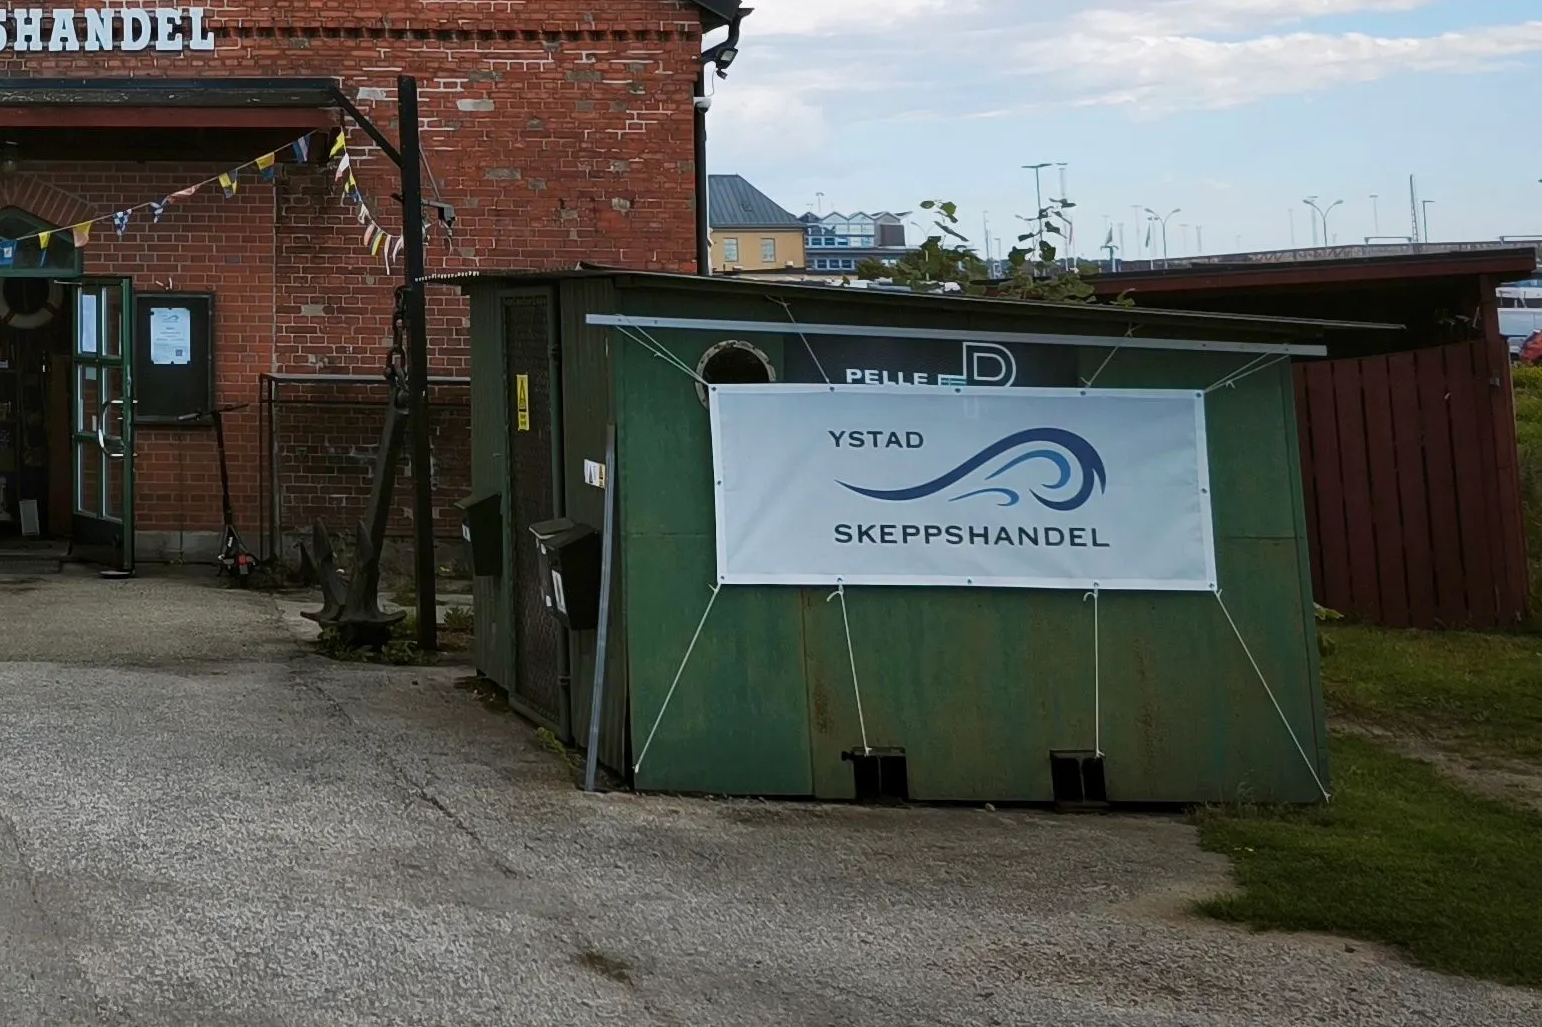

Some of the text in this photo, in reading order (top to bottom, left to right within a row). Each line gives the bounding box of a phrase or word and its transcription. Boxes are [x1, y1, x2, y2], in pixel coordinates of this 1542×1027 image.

[845, 368, 928, 385] PELLE
[828, 430, 924, 449] YSTAD
[834, 523, 1110, 548] SKEPPSHANDEL
